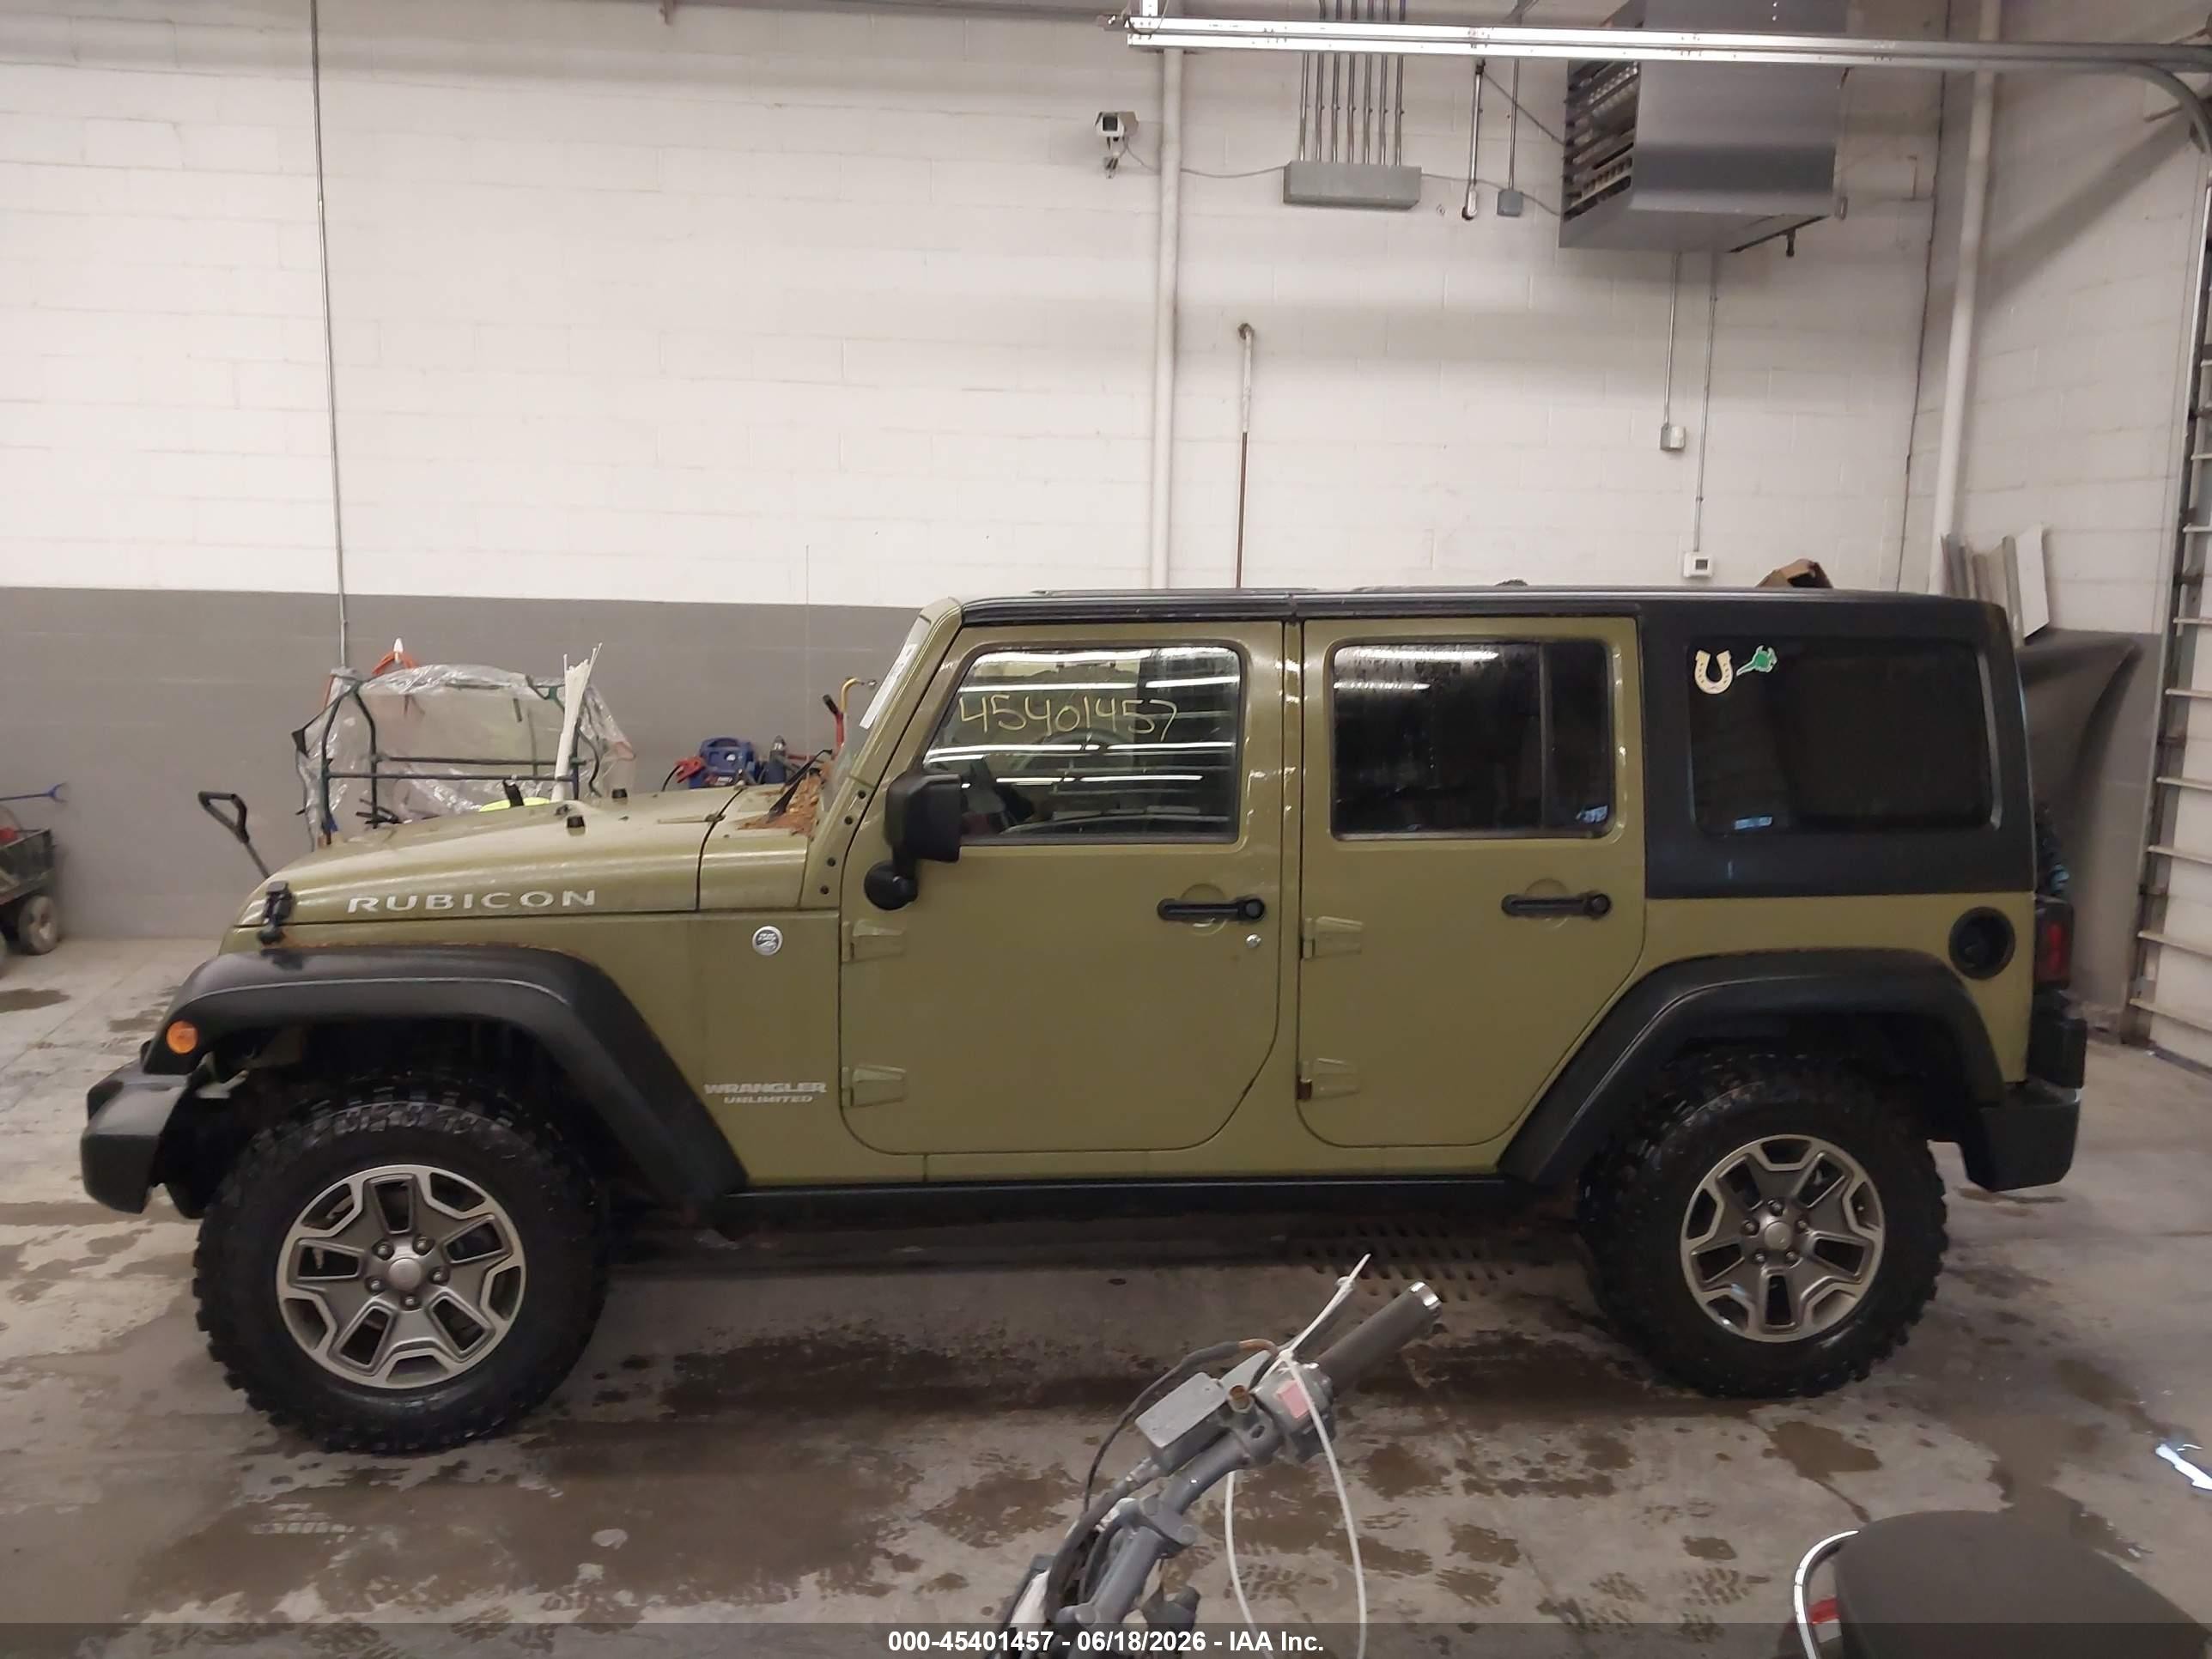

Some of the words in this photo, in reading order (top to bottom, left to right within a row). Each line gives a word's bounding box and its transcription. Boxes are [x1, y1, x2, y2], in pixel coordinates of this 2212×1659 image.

[958, 694, 1177, 742] 45401457
[347, 890, 596, 914] RUBICON
[704, 1083, 826, 1094] WRANGLER
[724, 1095, 813, 1104] UNLIMITED
